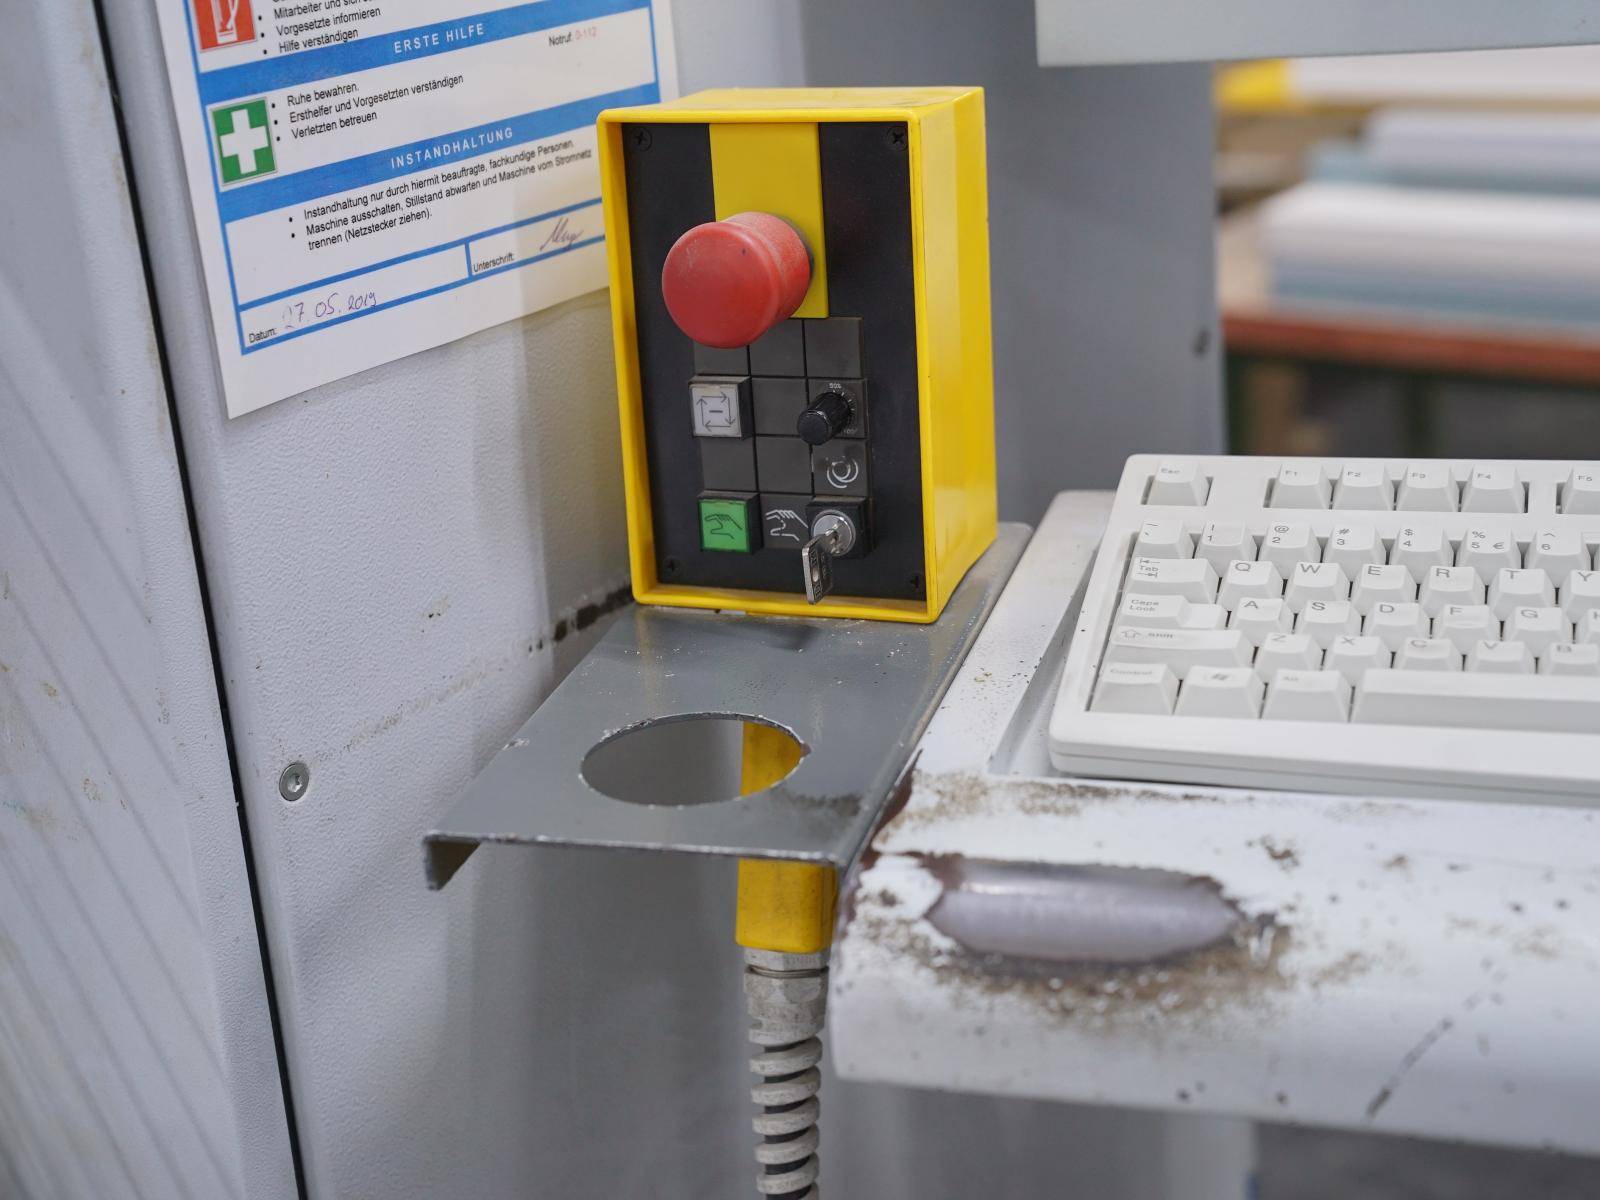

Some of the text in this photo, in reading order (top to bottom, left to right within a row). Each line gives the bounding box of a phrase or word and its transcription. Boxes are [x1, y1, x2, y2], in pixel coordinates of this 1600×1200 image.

[274, 2, 321, 19] Mitarbeiter
[325, 0, 341, 9] und
[276, 7, 382, 36] Vorgesetzte informieren
[279, 29, 359, 53] Hilfe verständigen
[394, 23, 485, 54] ERSTE HILFE
[287, 93, 312, 107] Ruhe
[289, 74, 464, 123] Ersthelfer und Vorgesetzten verständigen
[291, 111, 377, 140] Verletzten betreuen
[390, 127, 514, 169] INSTANDHALTUNG
[304, 139, 574, 220] Instandhaltung nur durch hiermit beauftragte, fachkundige Personen
[306, 149, 592, 236] Maschine ausschalten, Stillstand abwarten und Maschine vom Stromnetz
[308, 208, 433, 250] trennen (Netzstecker ziehen).
[1274, 525, 1289, 533] @
[1404, 528, 1413, 537] $
[1472, 531, 1485, 539] %
[1336, 538, 1345, 546] 3
[1235, 562, 1250, 573] Q
[1300, 563, 1321, 574] W
[1367, 566, 1382, 576] E
[1436, 568, 1450, 578] R
[1506, 570, 1521, 579] T
[1577, 572, 1592, 582] Y
[1243, 601, 1259, 610] A
[1311, 602, 1325, 611] S
[1379, 604, 1394, 613] D
[1450, 607, 1463, 615] F
[1520, 609, 1538, 619] G
[1272, 635, 1286, 643] Z
[1341, 637, 1355, 645] X
[1411, 639, 1427, 648] C
[1484, 642, 1498, 650] V
